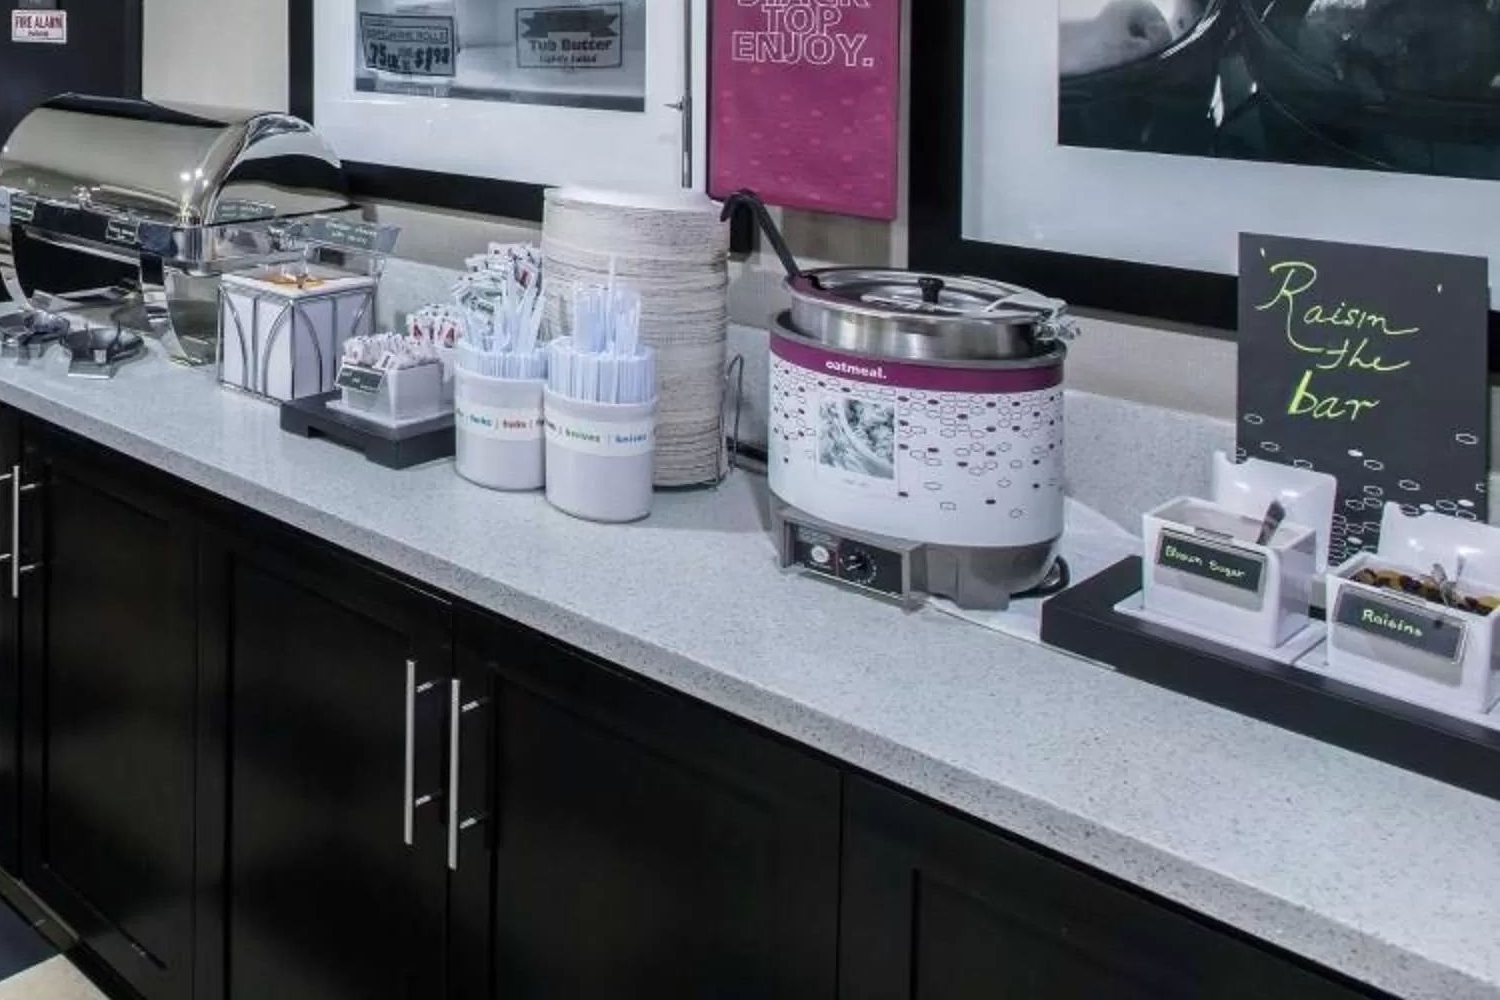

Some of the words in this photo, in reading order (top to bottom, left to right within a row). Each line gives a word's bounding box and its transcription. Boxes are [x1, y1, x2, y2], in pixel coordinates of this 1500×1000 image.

[15, 15, 32, 29] FIRE
[34, 15, 63, 29] ALARM
[761, 3, 842, 36] TOP
[528, 39, 557, 52] Tub
[561, 38, 612, 52] Butter
[731, 30, 874, 67] ENJOY.
[1316, 338, 1411, 371] the
[825, 361, 887, 379] oatmeal.
[1288, 370, 1381, 421] bar
[1361, 609, 1423, 637] Raisins
